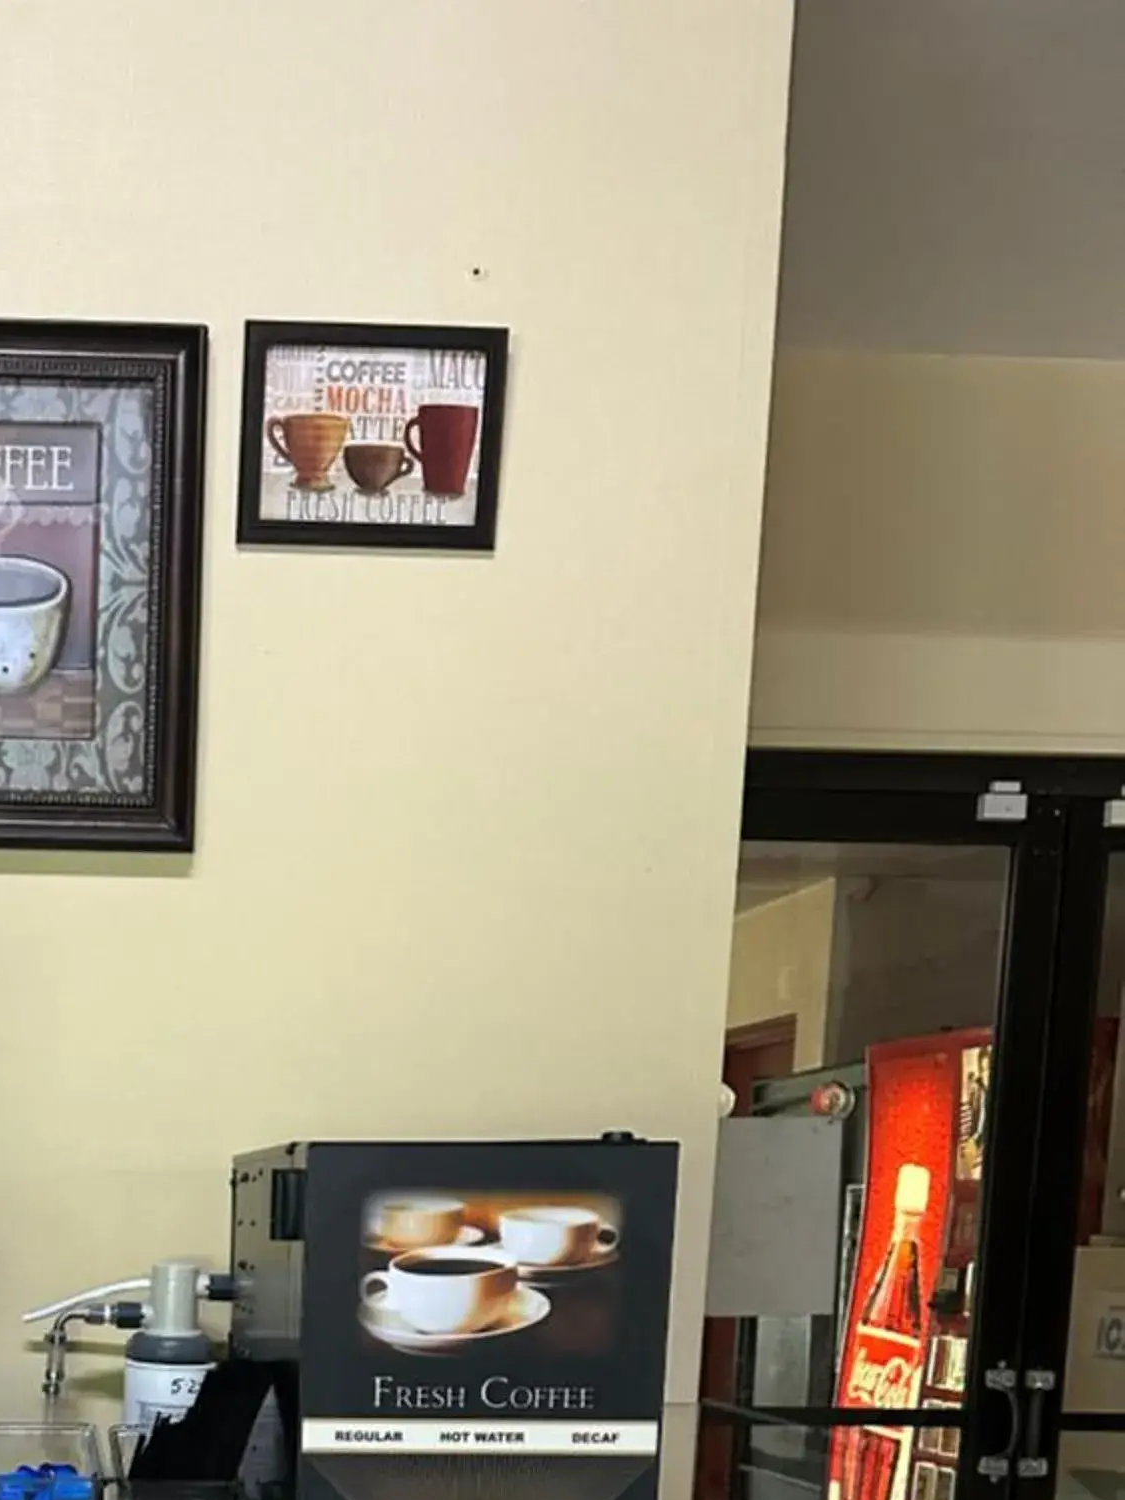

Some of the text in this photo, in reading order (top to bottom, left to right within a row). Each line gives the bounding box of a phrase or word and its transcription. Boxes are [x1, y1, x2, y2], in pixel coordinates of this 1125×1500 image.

[326, 359, 407, 384] COFFEE
[327, 386, 407, 415] MOCHA
[347, 416, 405, 442] ATTE
[286, 491, 447, 525] FRESH COFFEE
[373, 1376, 595, 1410] FRESH COFFEE
[334, 1430, 403, 1443] REGULAR
[439, 1431, 525, 1444] HOT WATER
[571, 1432, 620, 1445] DECAF
